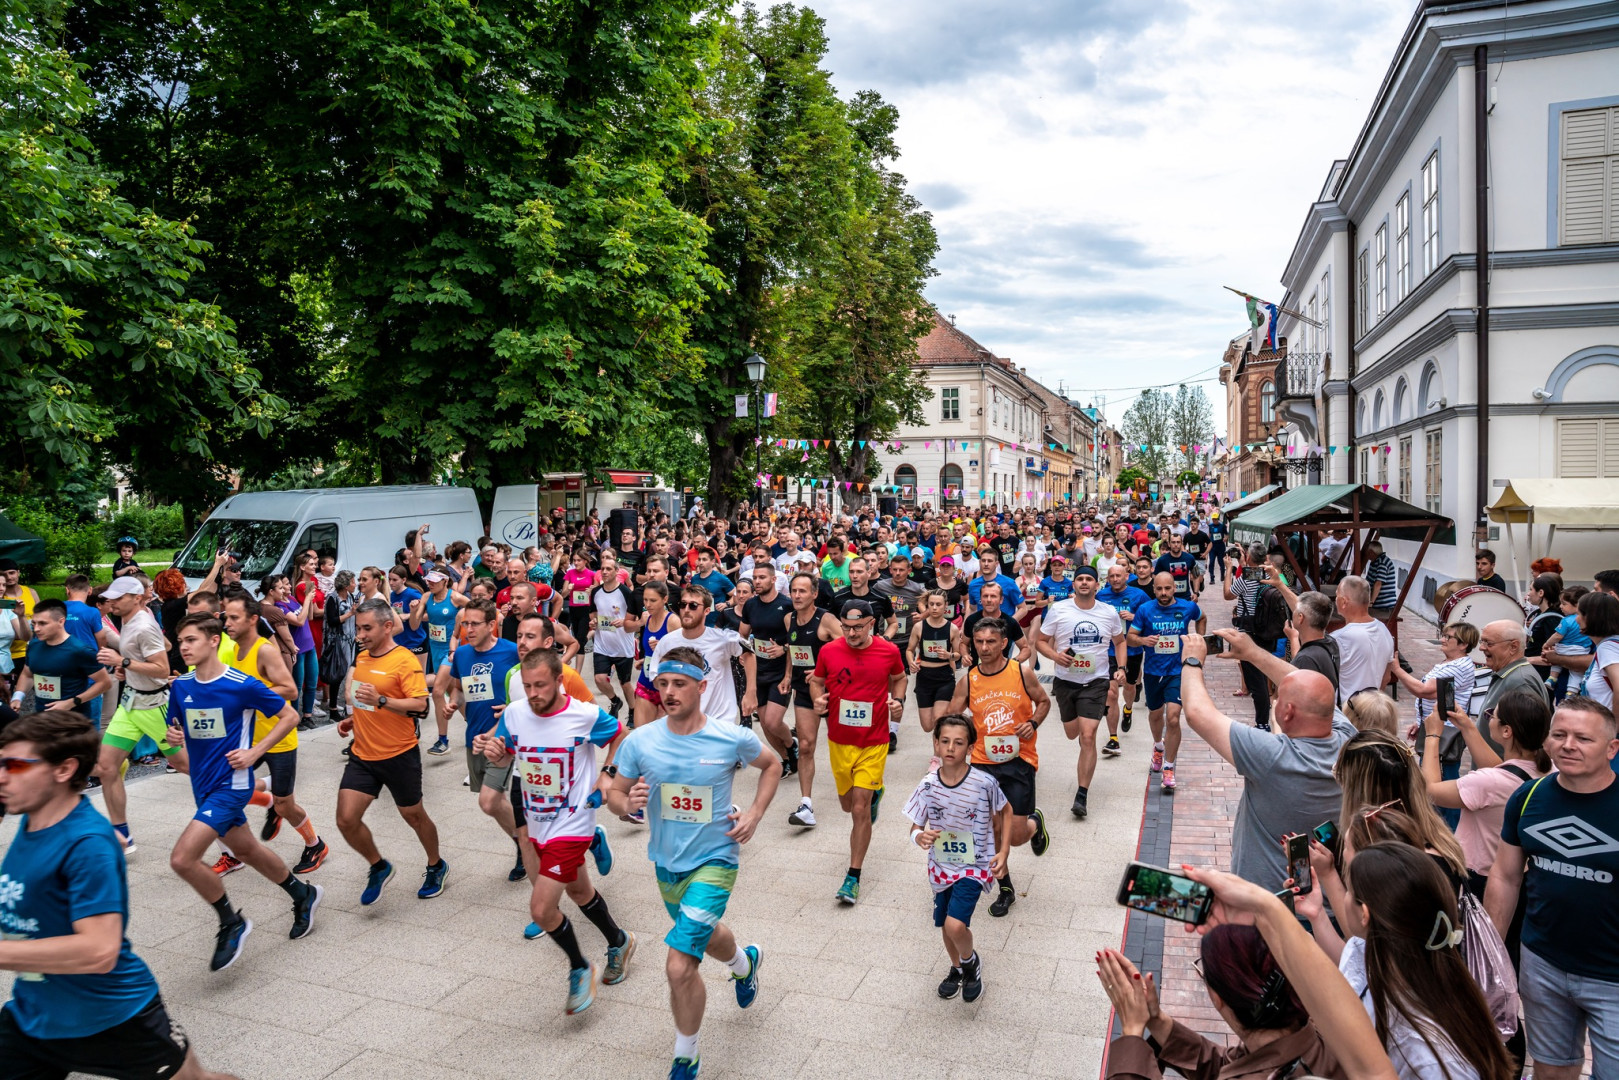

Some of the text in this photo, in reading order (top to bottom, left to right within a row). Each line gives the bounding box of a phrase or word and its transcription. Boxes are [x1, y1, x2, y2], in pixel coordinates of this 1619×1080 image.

[1152, 621, 1185, 631] KUTINA
[757, 645, 767, 653] 31
[1158, 641, 1175, 649] 332
[794, 652, 809, 660] 330
[1073, 660, 1090, 668] 326
[37, 682, 55, 692] 345
[467, 683, 487, 694] 272
[1005, 690, 1021, 700] LIGA
[845, 709, 866, 719] 115
[192, 718, 215, 730] 257
[983, 706, 1015, 734] Pitko
[991, 744, 1014, 754] 343
[526, 772, 552, 786] 328
[671, 796, 703, 811] 335
[942, 841, 967, 853] 153
[1531, 854, 1613, 884] UMBRO
